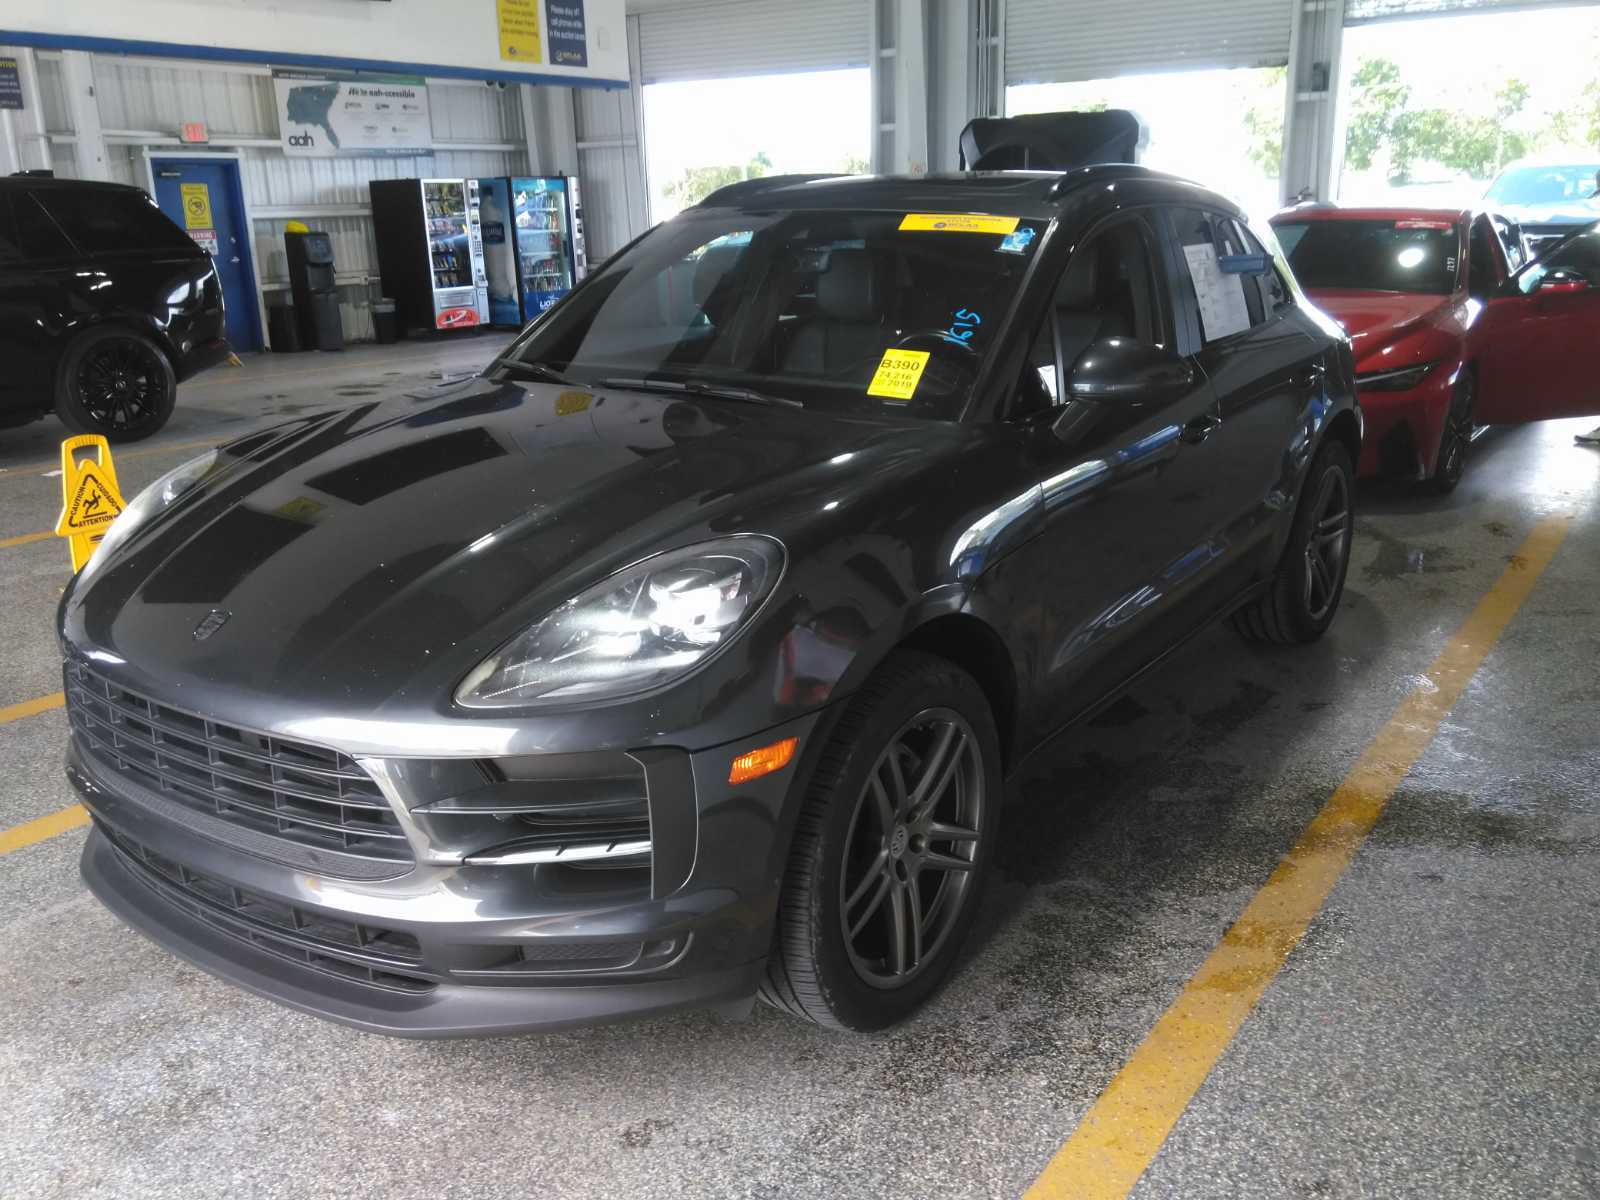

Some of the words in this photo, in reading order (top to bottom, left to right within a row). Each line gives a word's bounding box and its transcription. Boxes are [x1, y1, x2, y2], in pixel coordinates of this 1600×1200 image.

[880, 358, 920, 372] B390
[70, 485, 86, 516] CAUTION
[96, 483, 118, 507] CUIDADO
[78, 515, 113, 528] ATTENTION
